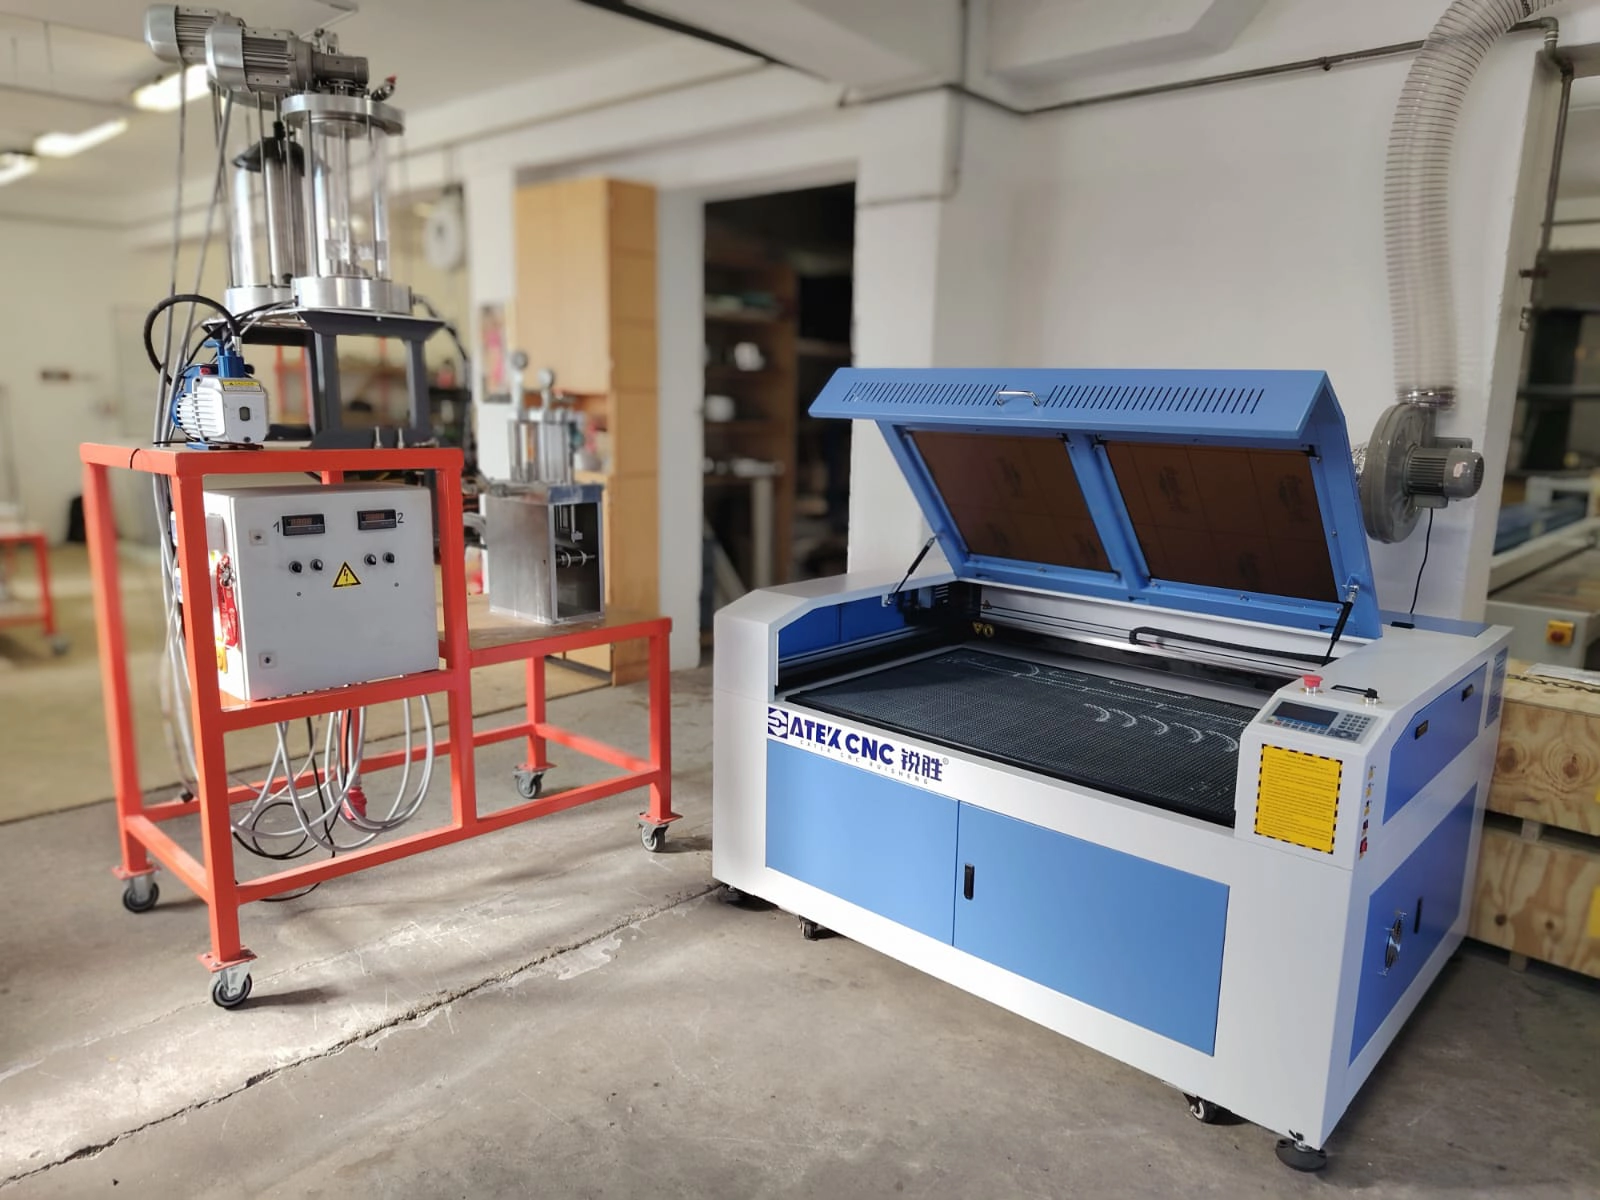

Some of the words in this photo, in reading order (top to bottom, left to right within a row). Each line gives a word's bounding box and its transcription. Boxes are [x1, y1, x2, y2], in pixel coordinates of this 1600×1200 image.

[396, 512, 405, 525] 2
[272, 520, 281, 534] 1
[844, 733, 896, 766] CNC
